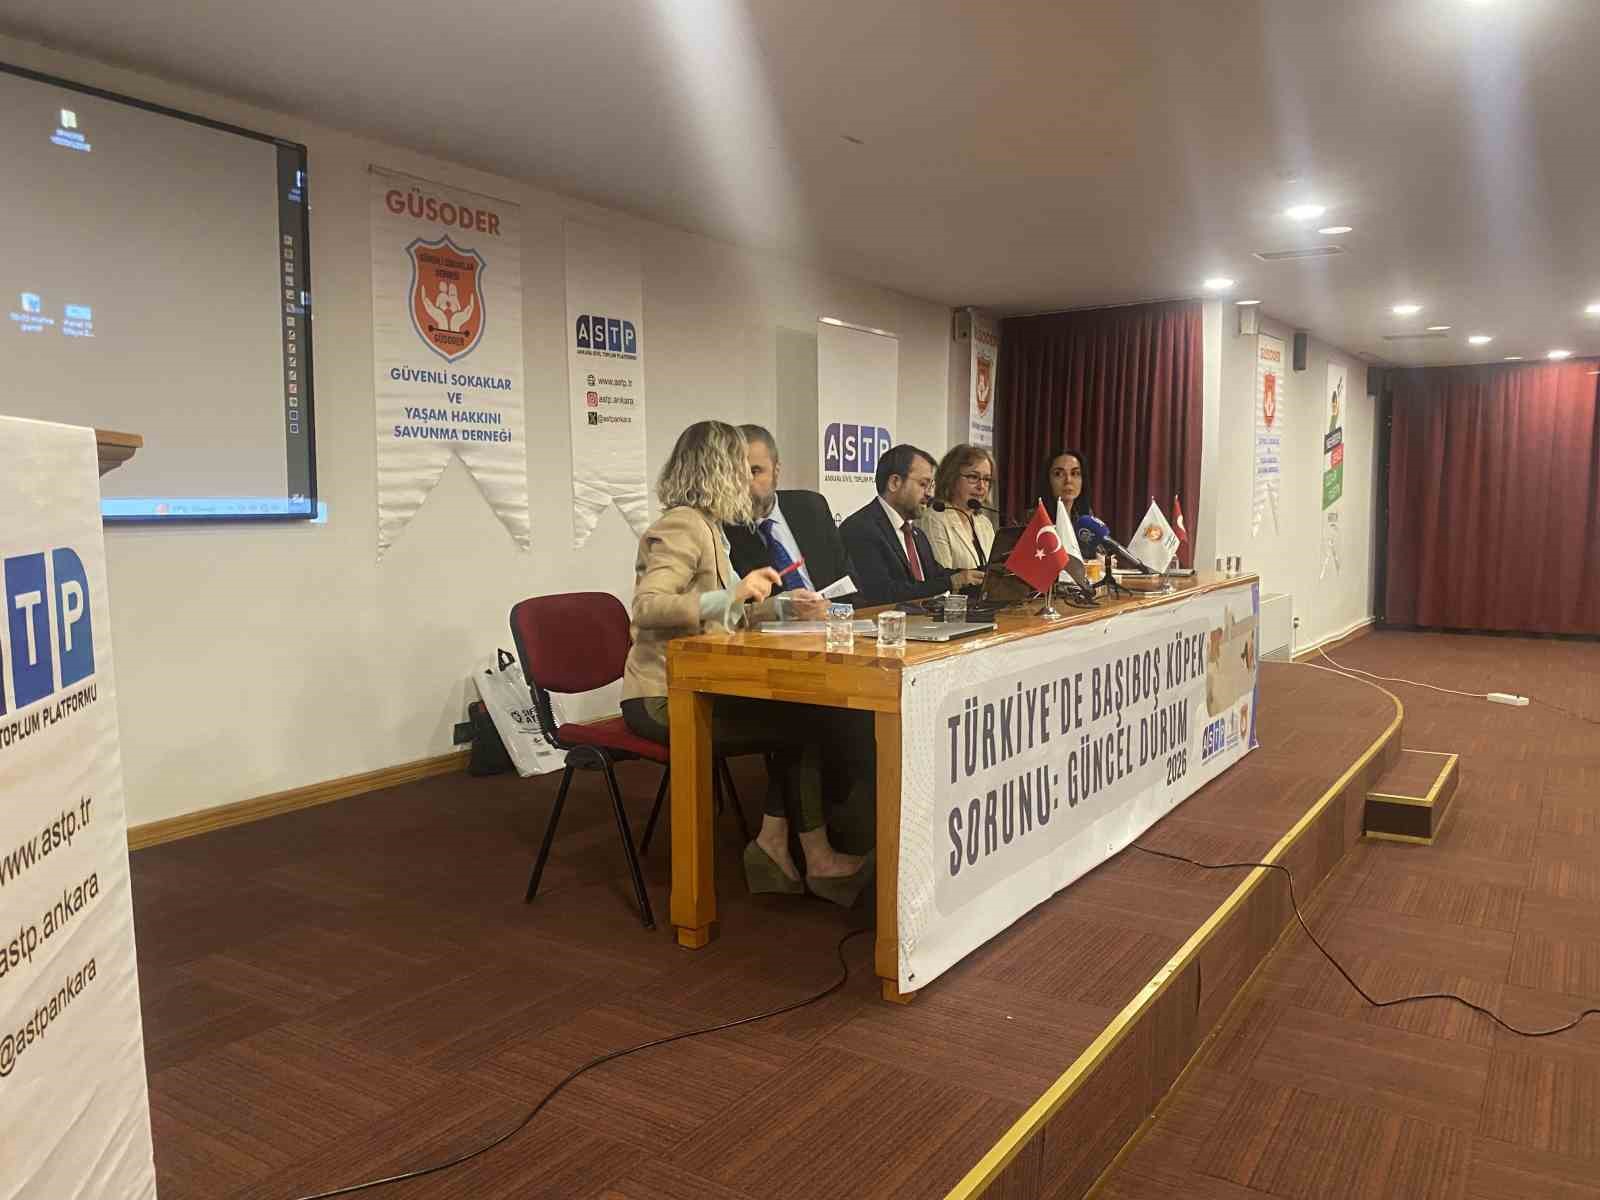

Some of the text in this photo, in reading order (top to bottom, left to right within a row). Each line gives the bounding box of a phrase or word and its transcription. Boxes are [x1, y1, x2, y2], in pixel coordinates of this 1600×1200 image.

[385, 187, 502, 236] GÜSODER
[577, 321, 634, 346] ASTP
[390, 365, 512, 391] GÜVENLİ SOKAKLAR
[404, 407, 501, 425] YAŞAM HAKKINI
[447, 393, 462, 404] VE
[393, 426, 512, 443] SAVUNMA DERNEĞİ
[825, 432, 890, 463] ASTP
[0, 682, 97, 749] TOPLUM PLATFORMU
[947, 632, 1205, 784] TÜRKİYE'DE BAŞIBOŞ KÖPEK
[1166, 748, 1188, 787] 2026
[948, 698, 1188, 877] SORUNU: GÜNCEL DURUM
[0, 872, 99, 978] astp.ankara
[0, 957, 97, 1078] @astpankara
